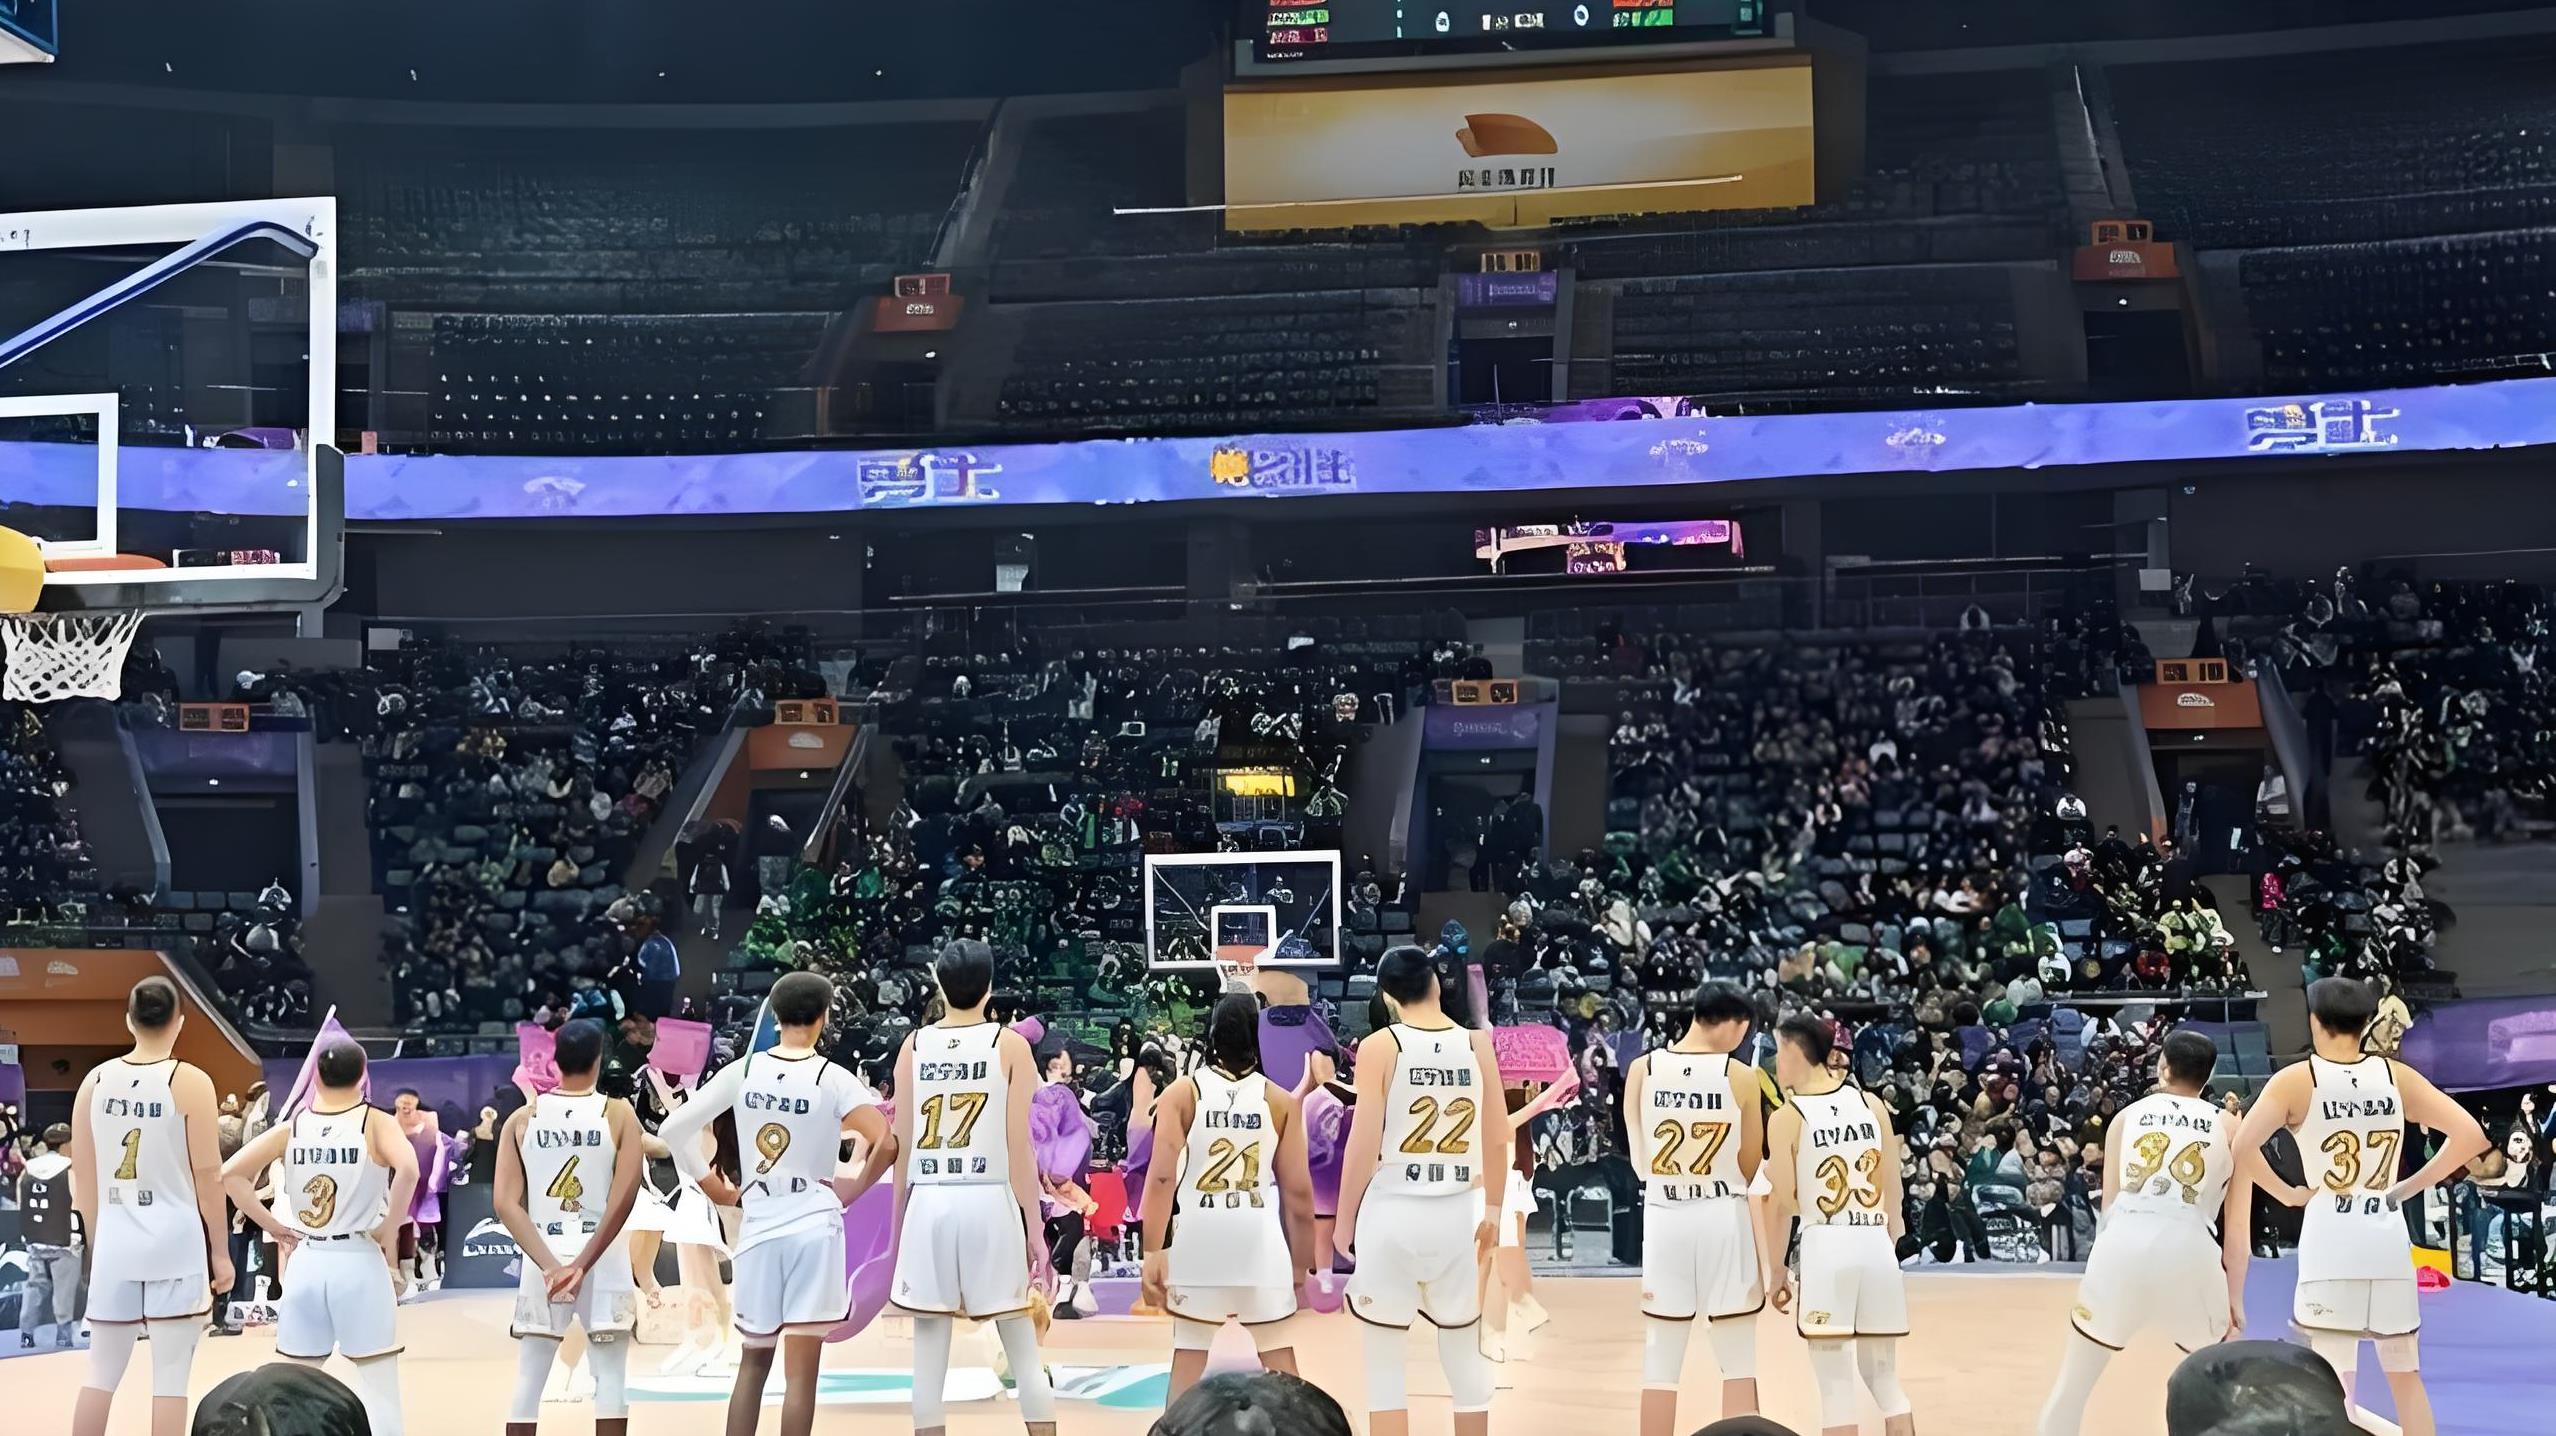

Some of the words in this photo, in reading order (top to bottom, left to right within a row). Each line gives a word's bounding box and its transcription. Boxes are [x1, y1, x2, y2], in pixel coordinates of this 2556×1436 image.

[755, 1121, 791, 1175] 9
[917, 1092, 989, 1150] 17
[1399, 1095, 1476, 1154] 22
[1651, 1118, 1732, 1176] 27
[114, 1127, 142, 1180] 1
[1196, 1137, 1260, 1193] 21
[1815, 1148, 1883, 1214] 33
[2320, 1128, 2401, 1193] 37
[298, 1173, 338, 1229] 3
